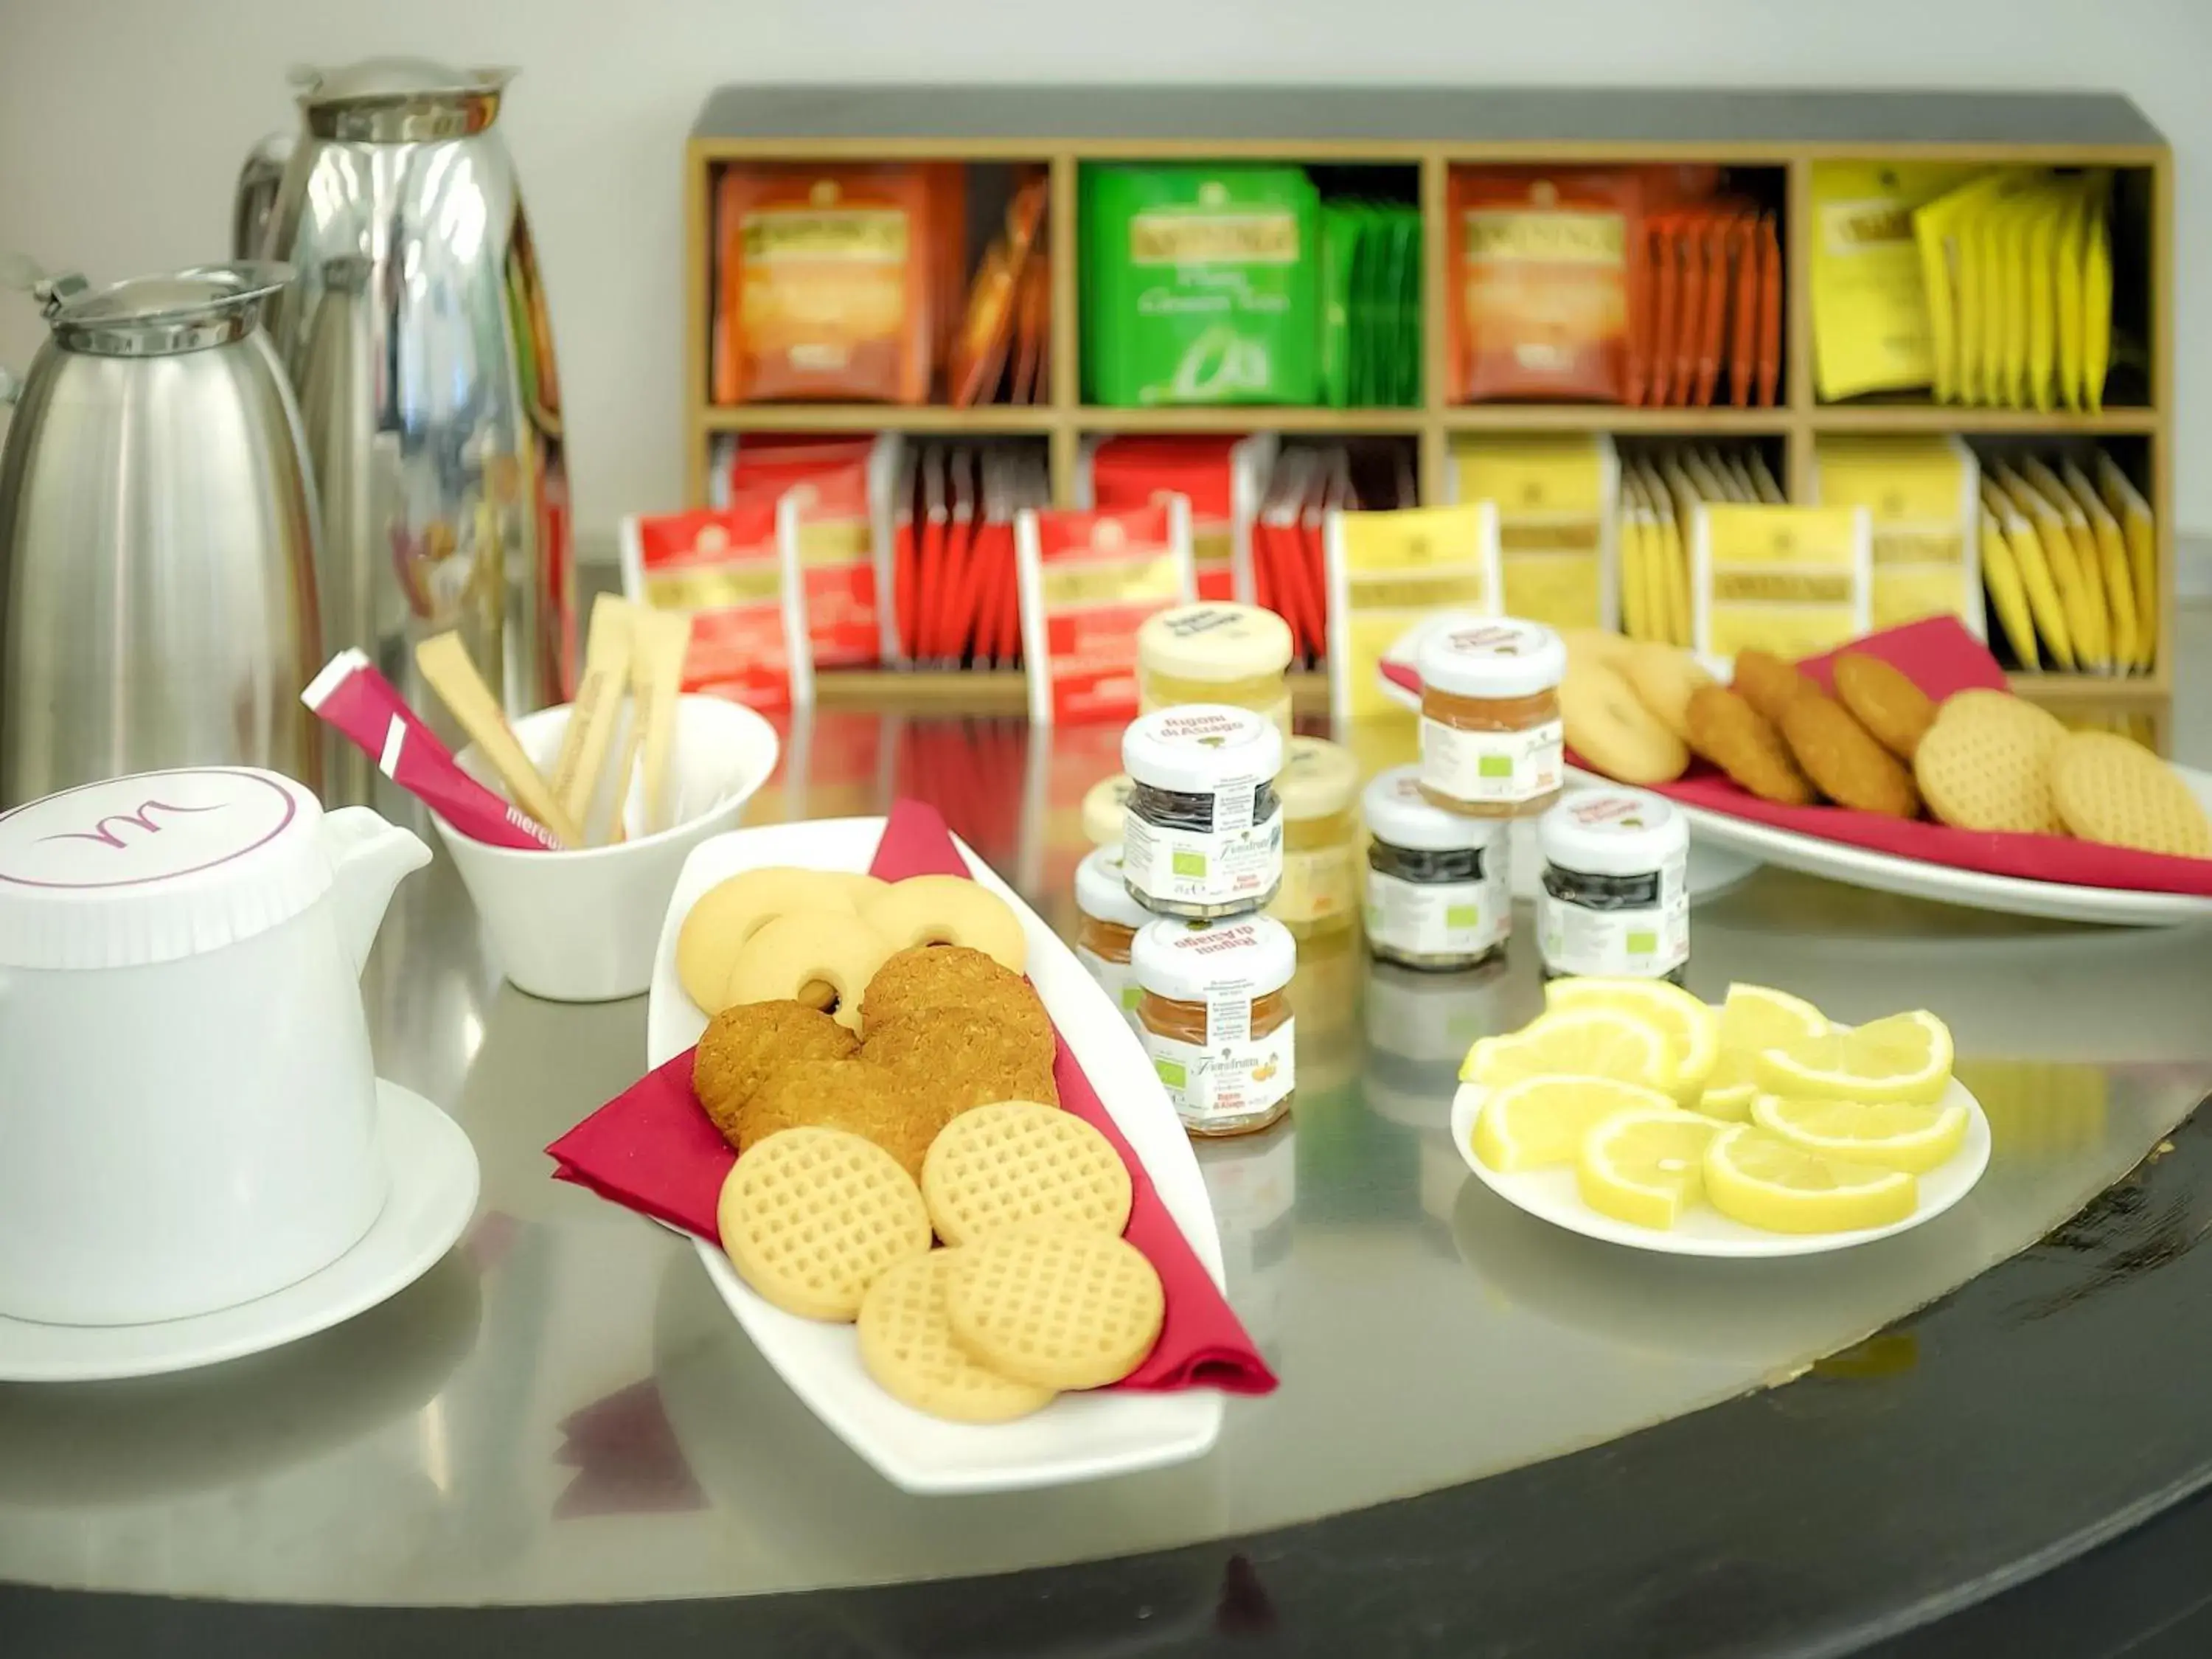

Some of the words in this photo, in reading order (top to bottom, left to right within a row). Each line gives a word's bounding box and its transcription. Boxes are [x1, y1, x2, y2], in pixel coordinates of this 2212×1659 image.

[1164, 715, 1227, 728] Rigoni
[1181, 722, 1245, 736] Asiago
[1174, 931, 1236, 948] Asiago
[1195, 937, 1258, 955] Rigoni
